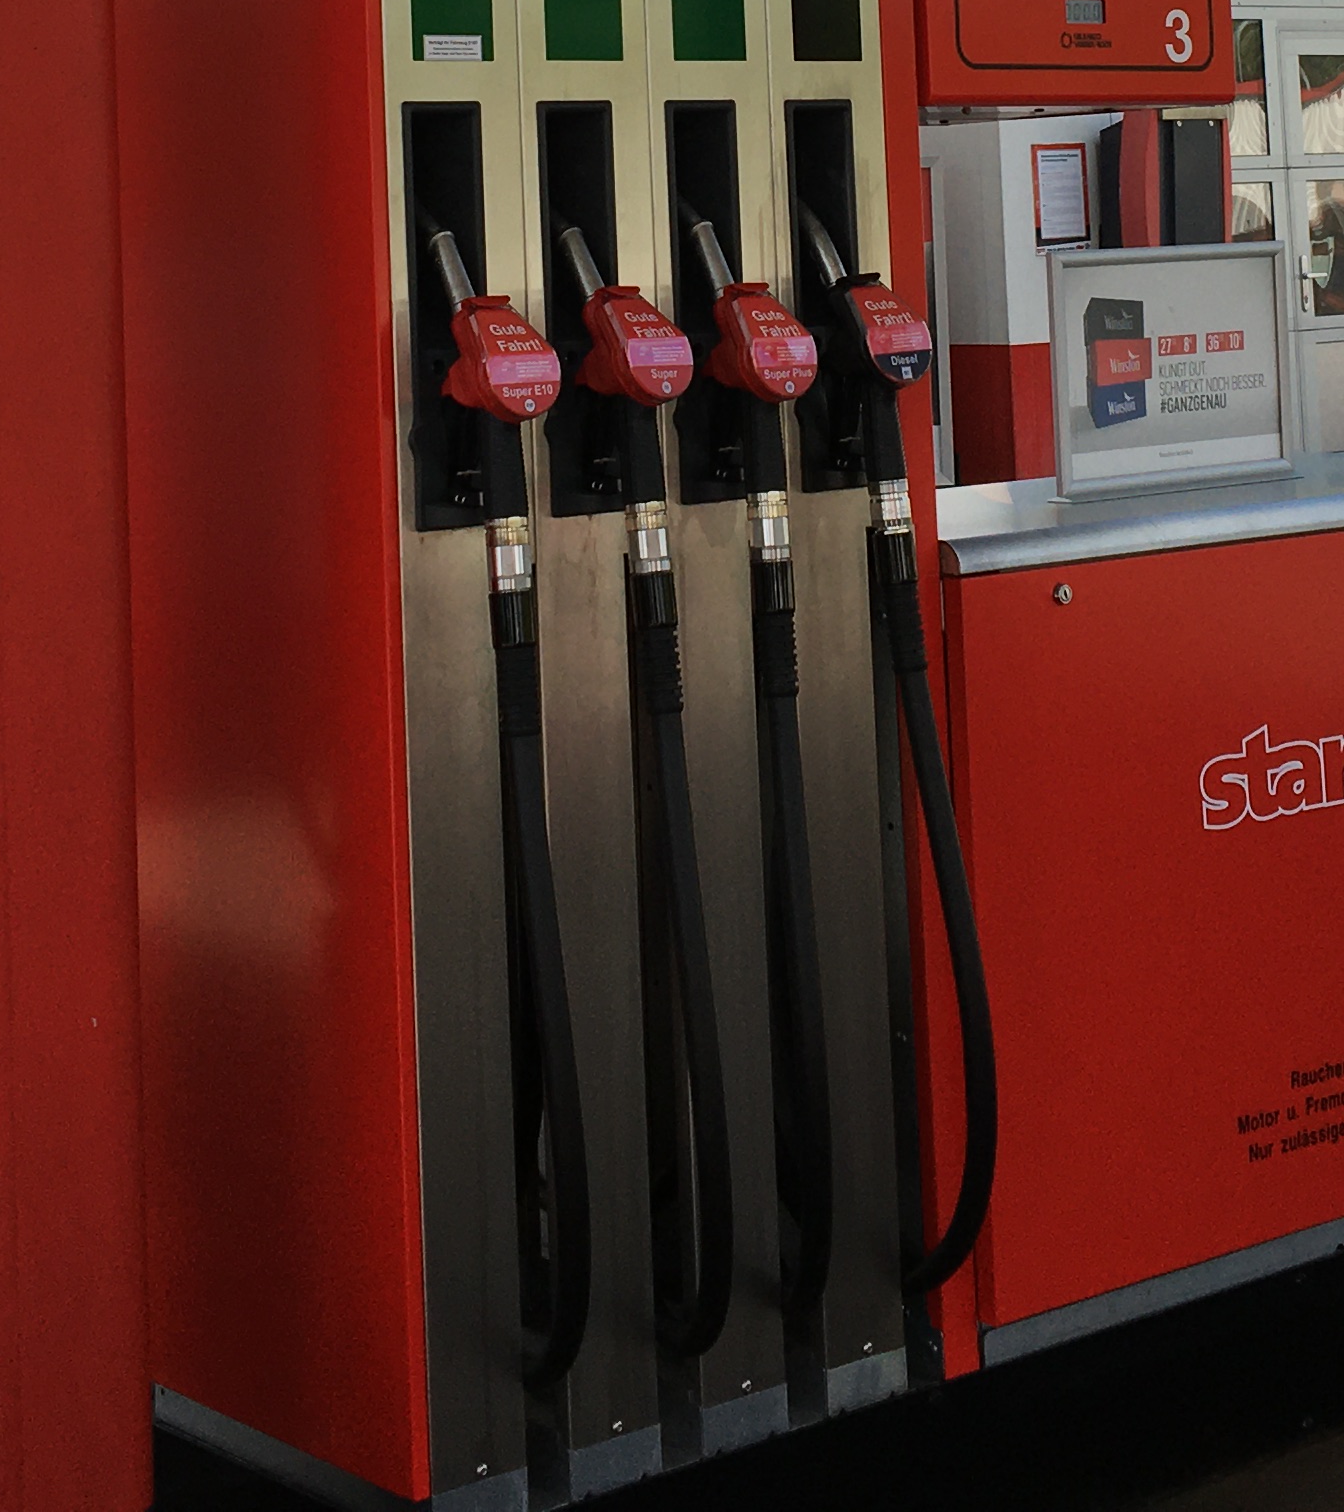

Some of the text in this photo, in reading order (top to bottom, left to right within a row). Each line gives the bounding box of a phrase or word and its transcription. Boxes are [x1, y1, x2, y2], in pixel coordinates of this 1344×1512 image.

[1165, 8, 1193, 63] 3
[864, 300, 897, 312] Gute
[624, 311, 658, 323] Gute
[751, 310, 785, 322] Gute
[872, 313, 914, 327] Fahrt!
[489, 324, 527, 336] Gute
[633, 326, 676, 338] Fahrt!
[759, 324, 801, 337] Fahrt!
[497, 339, 543, 352] Fahrt!
[1160, 338, 1172, 354] 27
[1208, 334, 1220, 351] 36
[890, 354, 918, 366] Diesel
[1109, 356, 1141, 374] Winston
[650, 368, 678, 381] Super
[764, 368, 812, 381] Super Plus
[1159, 362, 1187, 378] KLINGT
[502, 384, 553, 399] Super E10
[1159, 379, 1204, 397] SCHMECKT
[1206, 377, 1230, 392] NOCH
[1160, 393, 1227, 413] #GANZGENAU
[1237, 1109, 1280, 1135] Motor
[1287, 1105, 1300, 1121] u.
[1248, 1142, 1273, 1163] Nur
